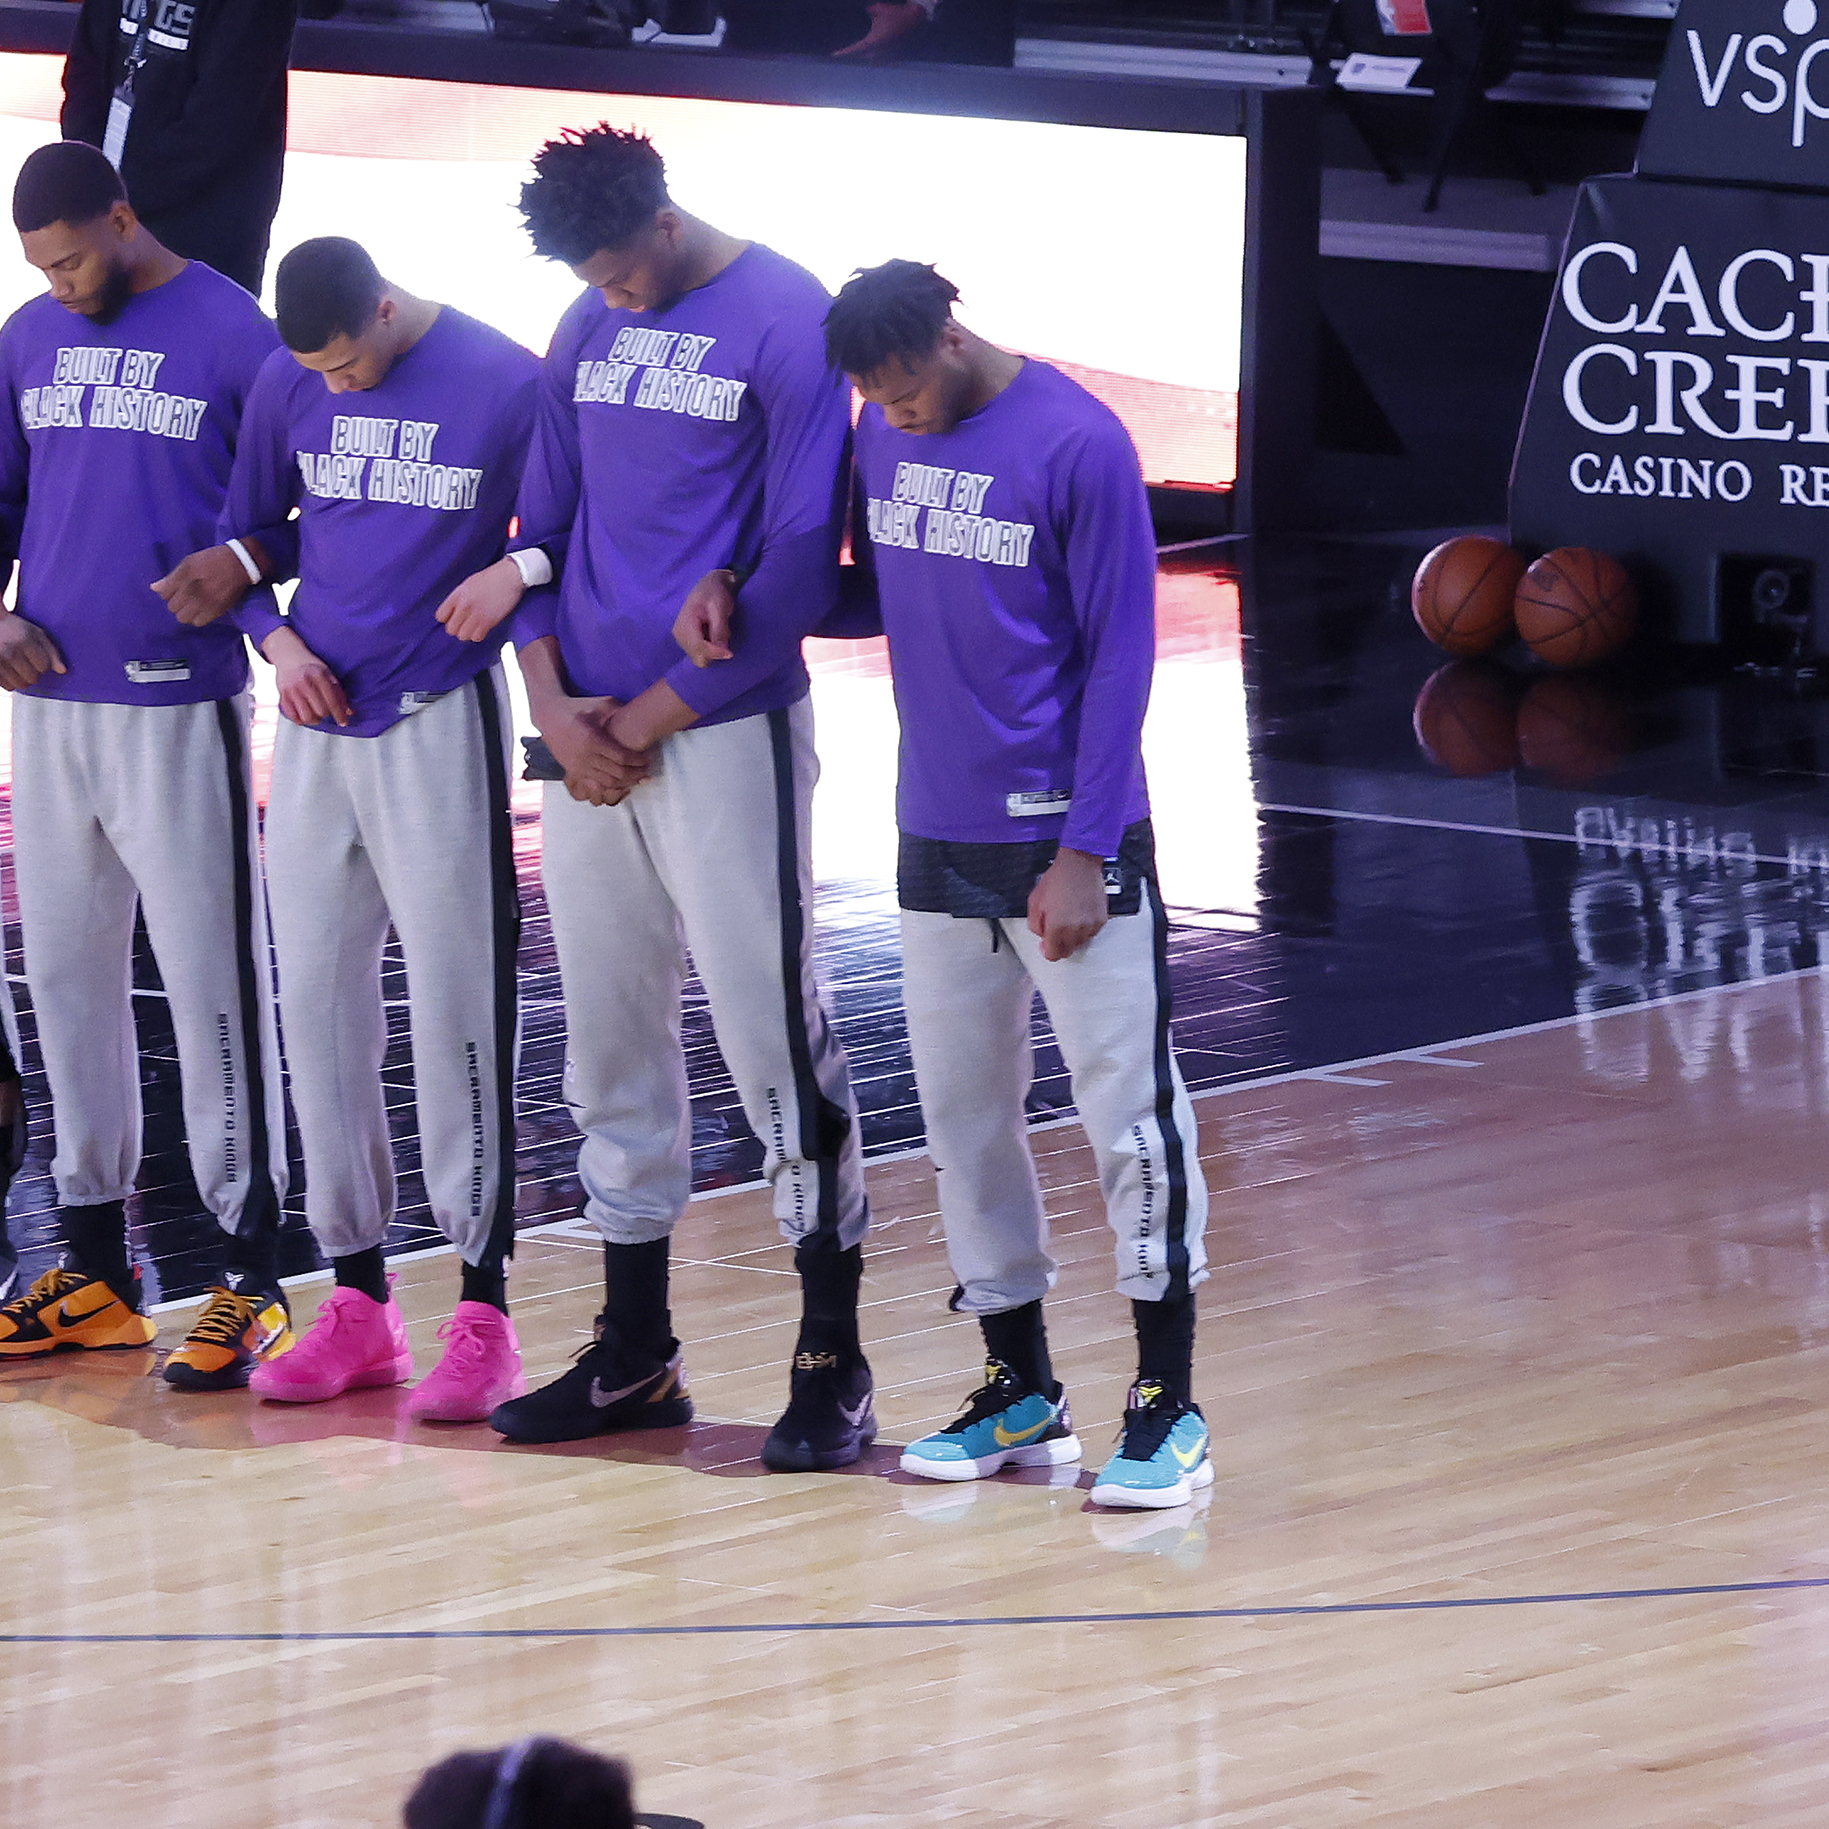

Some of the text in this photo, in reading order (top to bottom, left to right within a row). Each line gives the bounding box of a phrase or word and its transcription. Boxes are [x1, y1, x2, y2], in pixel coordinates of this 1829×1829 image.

[53, 346, 165, 389] BUILT BY
[608, 326, 716, 372] BUILT BY
[89, 386, 208, 441] HISTORY
[634, 369, 747, 423] HISTORY
[331, 415, 439, 462] BUILT BY
[296, 450, 483, 511] LACK HISTORY
[891, 460, 994, 515] BUILT BY
[1569, 452, 1754, 502] CASINO
[923, 509, 1035, 568] HISTORY
